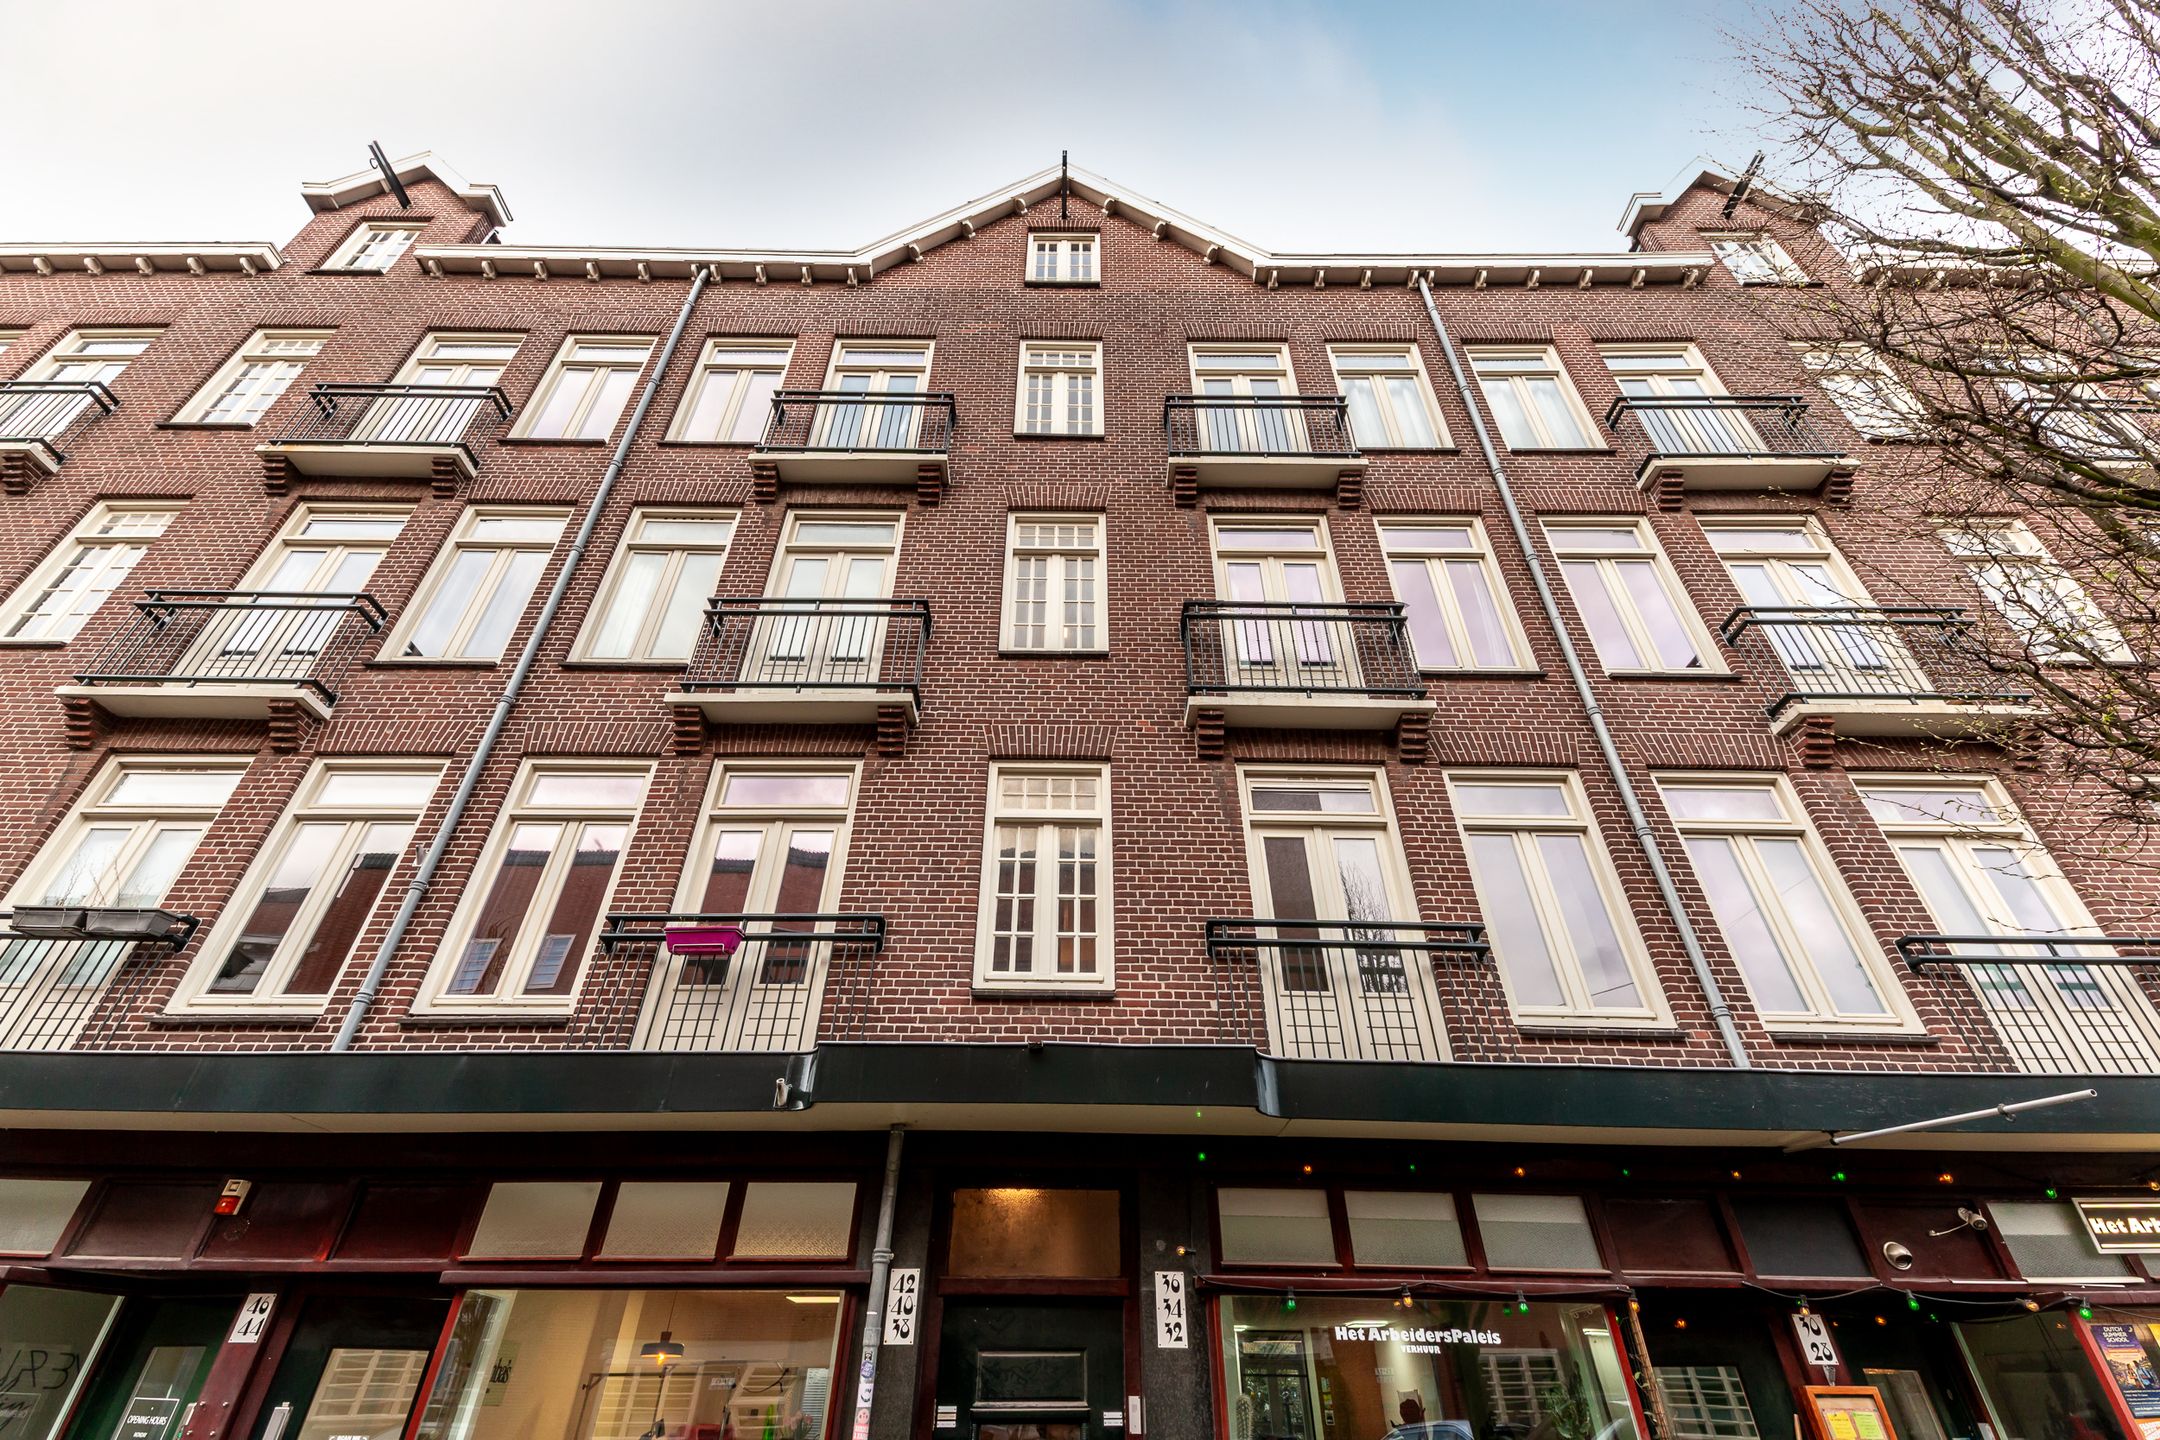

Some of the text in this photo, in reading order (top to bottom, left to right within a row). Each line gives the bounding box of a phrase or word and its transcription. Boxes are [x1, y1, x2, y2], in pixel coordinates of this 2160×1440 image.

[2088, 1217, 2129, 1234] Het
[893, 1273, 916, 1293] 42
[1162, 1273, 1181, 1294] 36
[246, 1295, 270, 1315] 46
[890, 1295, 914, 1315] 40
[1163, 1298, 1183, 1320] 34
[237, 1317, 266, 1336] 44
[892, 1318, 910, 1340] 38
[1164, 1321, 1183, 1344] 32
[1334, 1326, 1502, 1345] Het ArbeidersPaleis
[1798, 1315, 1822, 1337] 30
[1400, 1345, 1441, 1355] VERHUUR
[1810, 1341, 1834, 1362] 28
[127, 1415, 168, 1426] OPENING HOURS
